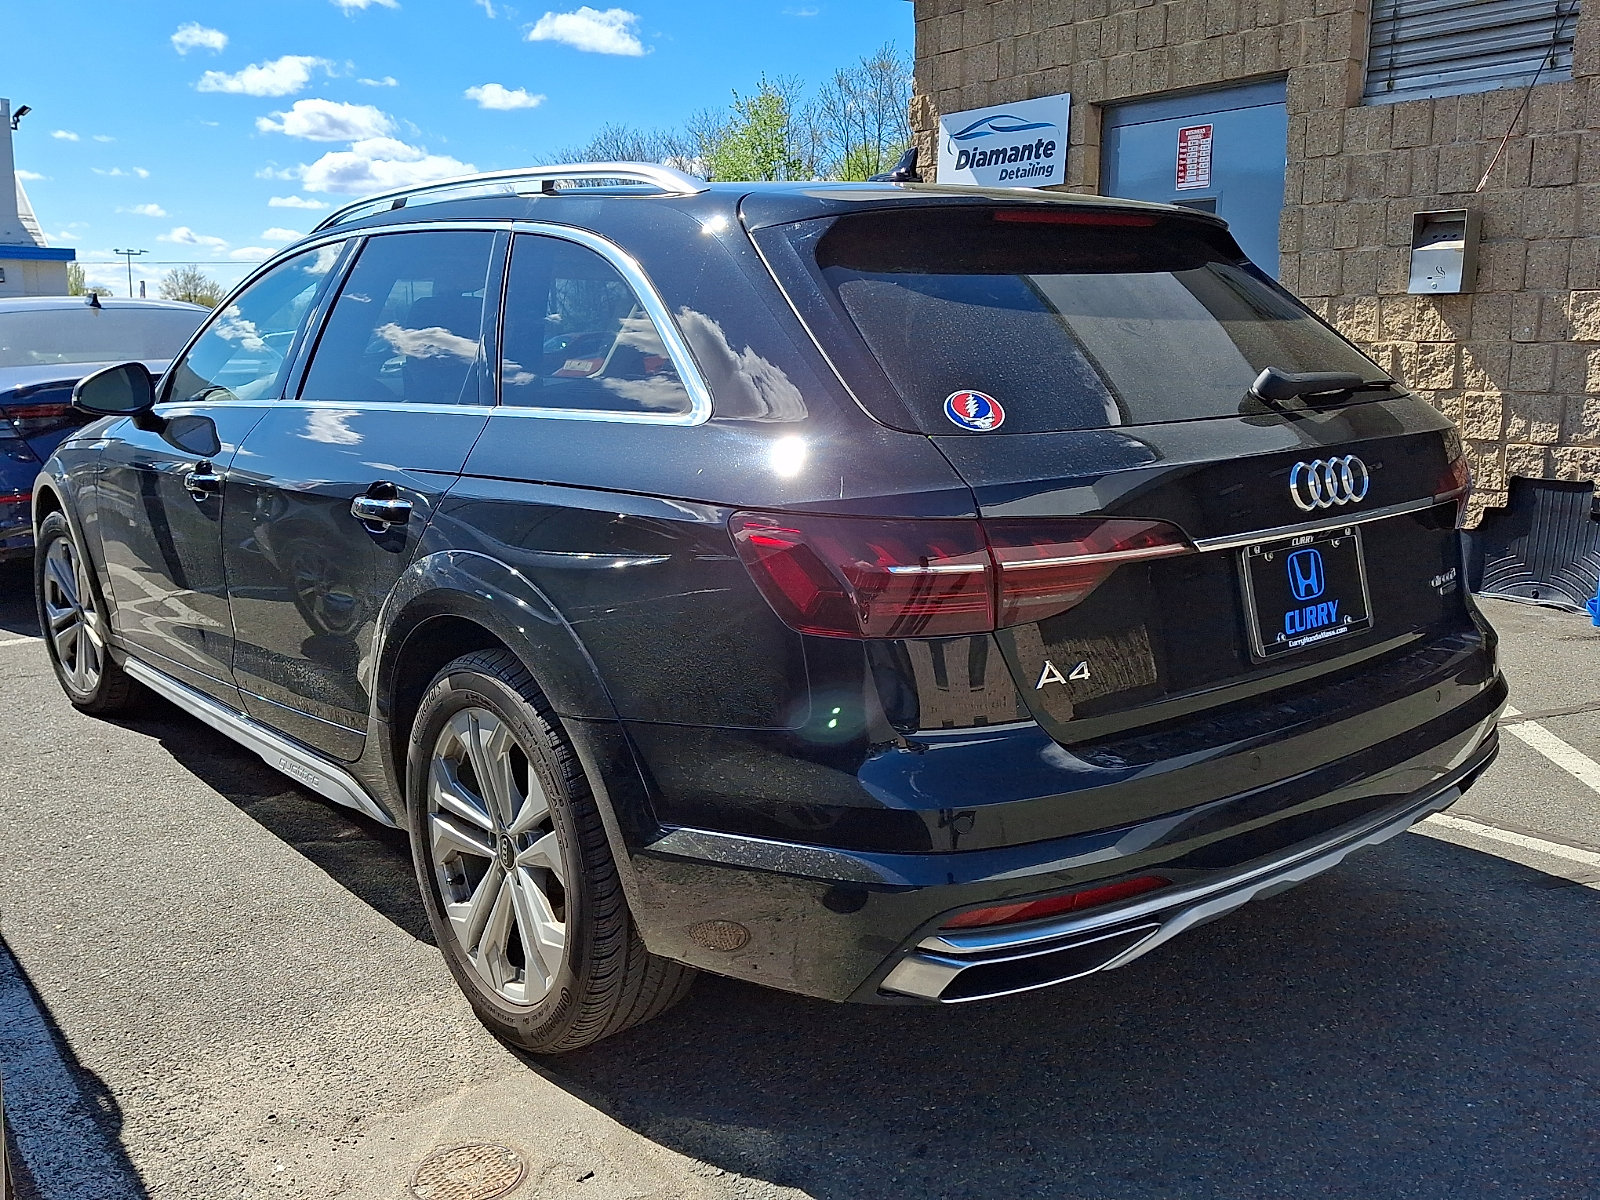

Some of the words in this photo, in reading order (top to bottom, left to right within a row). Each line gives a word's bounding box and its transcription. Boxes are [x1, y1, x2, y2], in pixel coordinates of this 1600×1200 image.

[955, 138, 1056, 171] Diamante
[998, 161, 1055, 181] Detailing
[1291, 535, 1315, 547] CURRY
[1284, 599, 1339, 635] CURRY
[1035, 660, 1091, 690] A4
